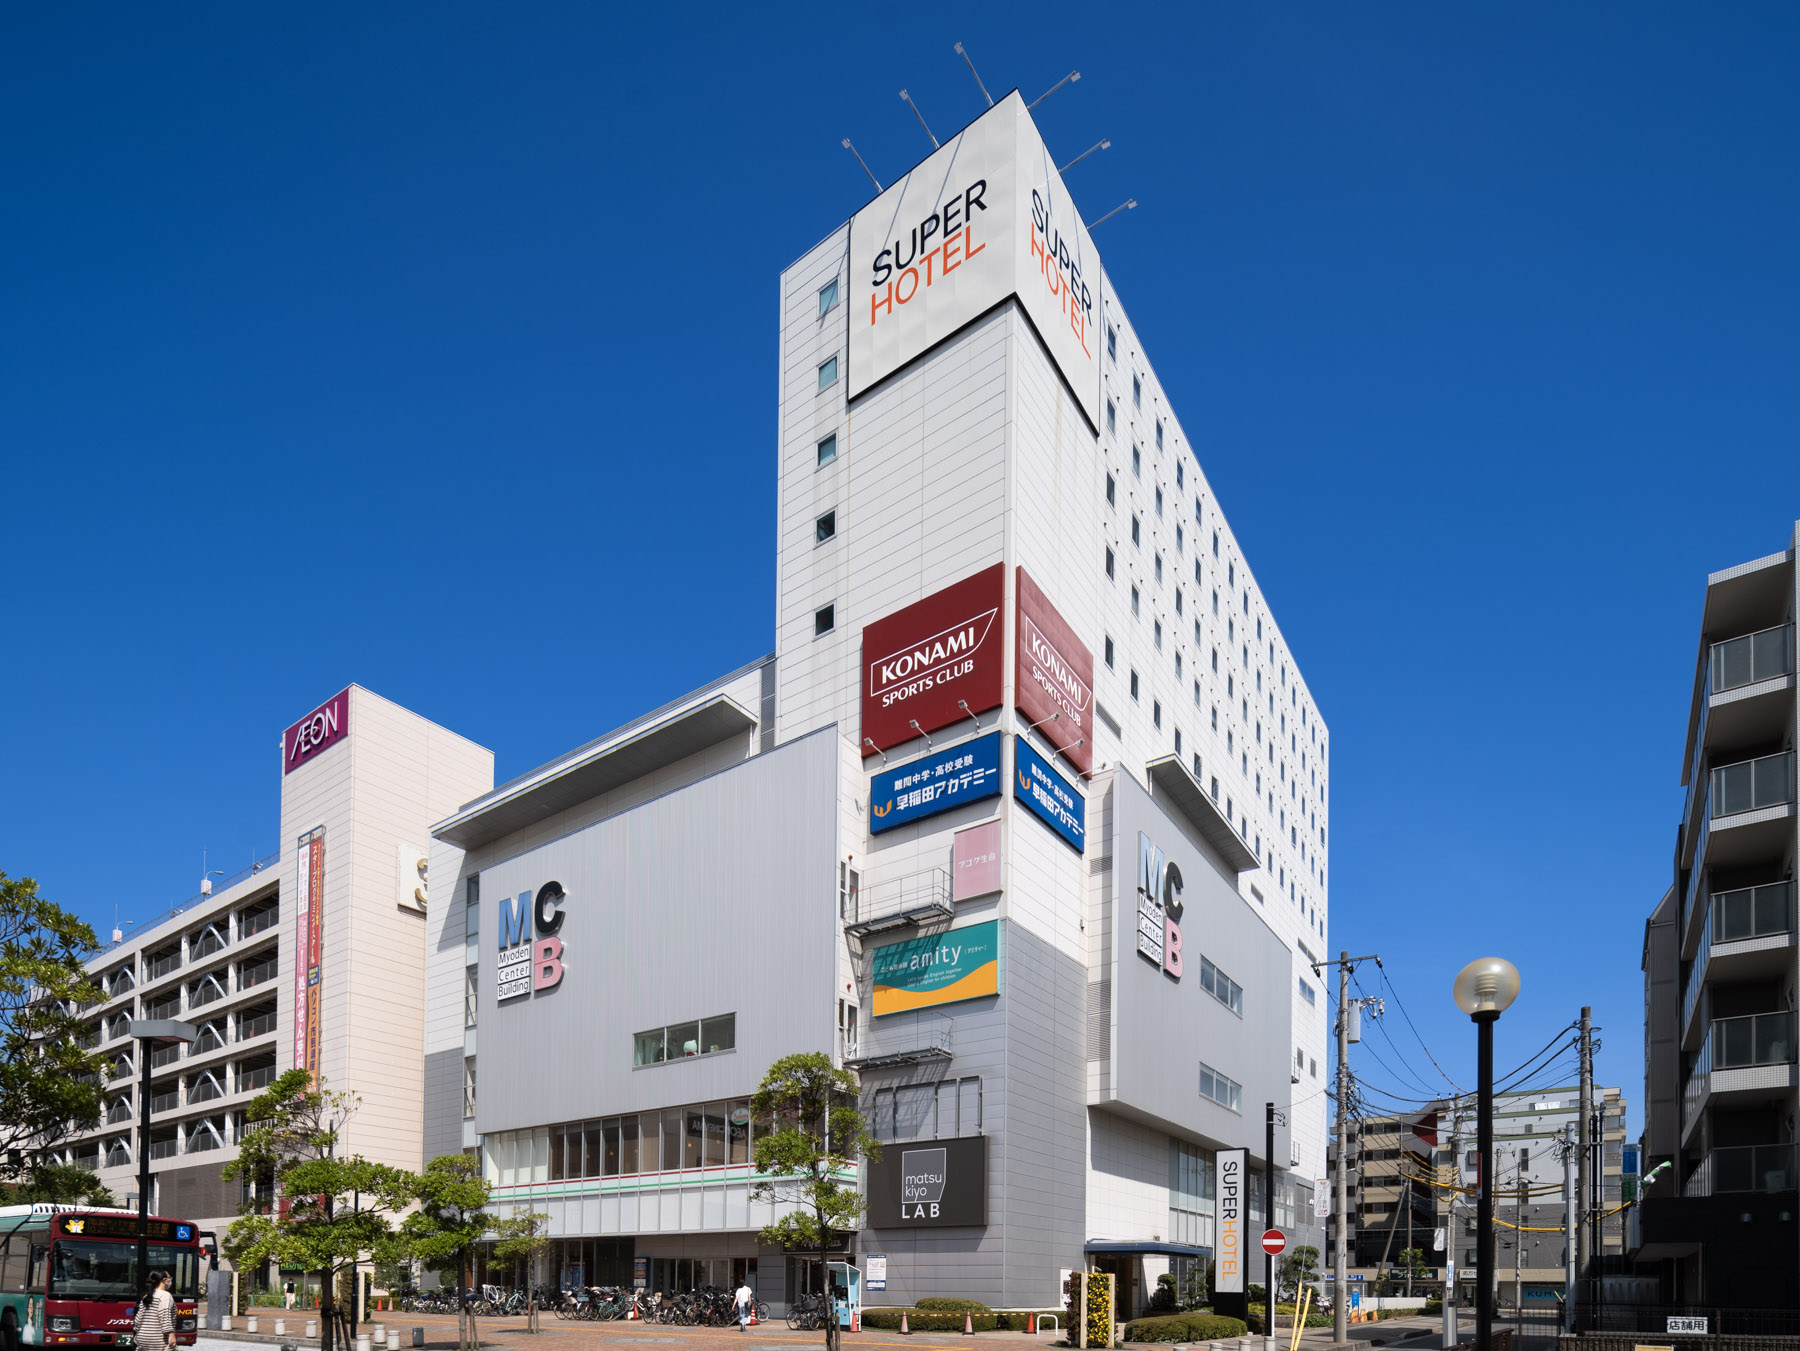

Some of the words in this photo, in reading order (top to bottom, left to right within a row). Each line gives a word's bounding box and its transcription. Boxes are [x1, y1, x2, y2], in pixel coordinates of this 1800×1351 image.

[872, 179, 987, 286] SUPER
[871, 225, 986, 326] HOTEL
[1031, 189, 1092, 327] SUPER
[1031, 221, 1091, 360] HOTEL
[881, 626, 974, 684] KONAMI
[1032, 632, 1082, 705] KONAMI
[882, 676, 933, 708] SPORTS
[936, 659, 974, 685] CLUB
[1032, 665, 1062, 704] SPORTS
[1062, 701, 1081, 726] CLUB
[896, 767, 997, 810] 早稲田アカデミー
[1032, 782, 1084, 836] 早稲田アカデミー
[958, 852, 996, 868] フコク生命
[1140, 895, 1162, 924] Myoden
[1140, 917, 1162, 943] Center
[498, 947, 529, 965] Myoden
[910, 945, 961, 970] amity
[1140, 934, 1162, 964] Building
[498, 965, 529, 981] Center
[498, 981, 529, 997] Building
[905, 1173, 942, 1185] matsu
[905, 1185, 927, 1201] kiyo
[1222, 1161, 1238, 1220] SUPER
[902, 1203, 940, 1219] LAB
[1222, 1220, 1238, 1281] HOTEL
[1668, 1320, 1705, 1331] 店舗用
